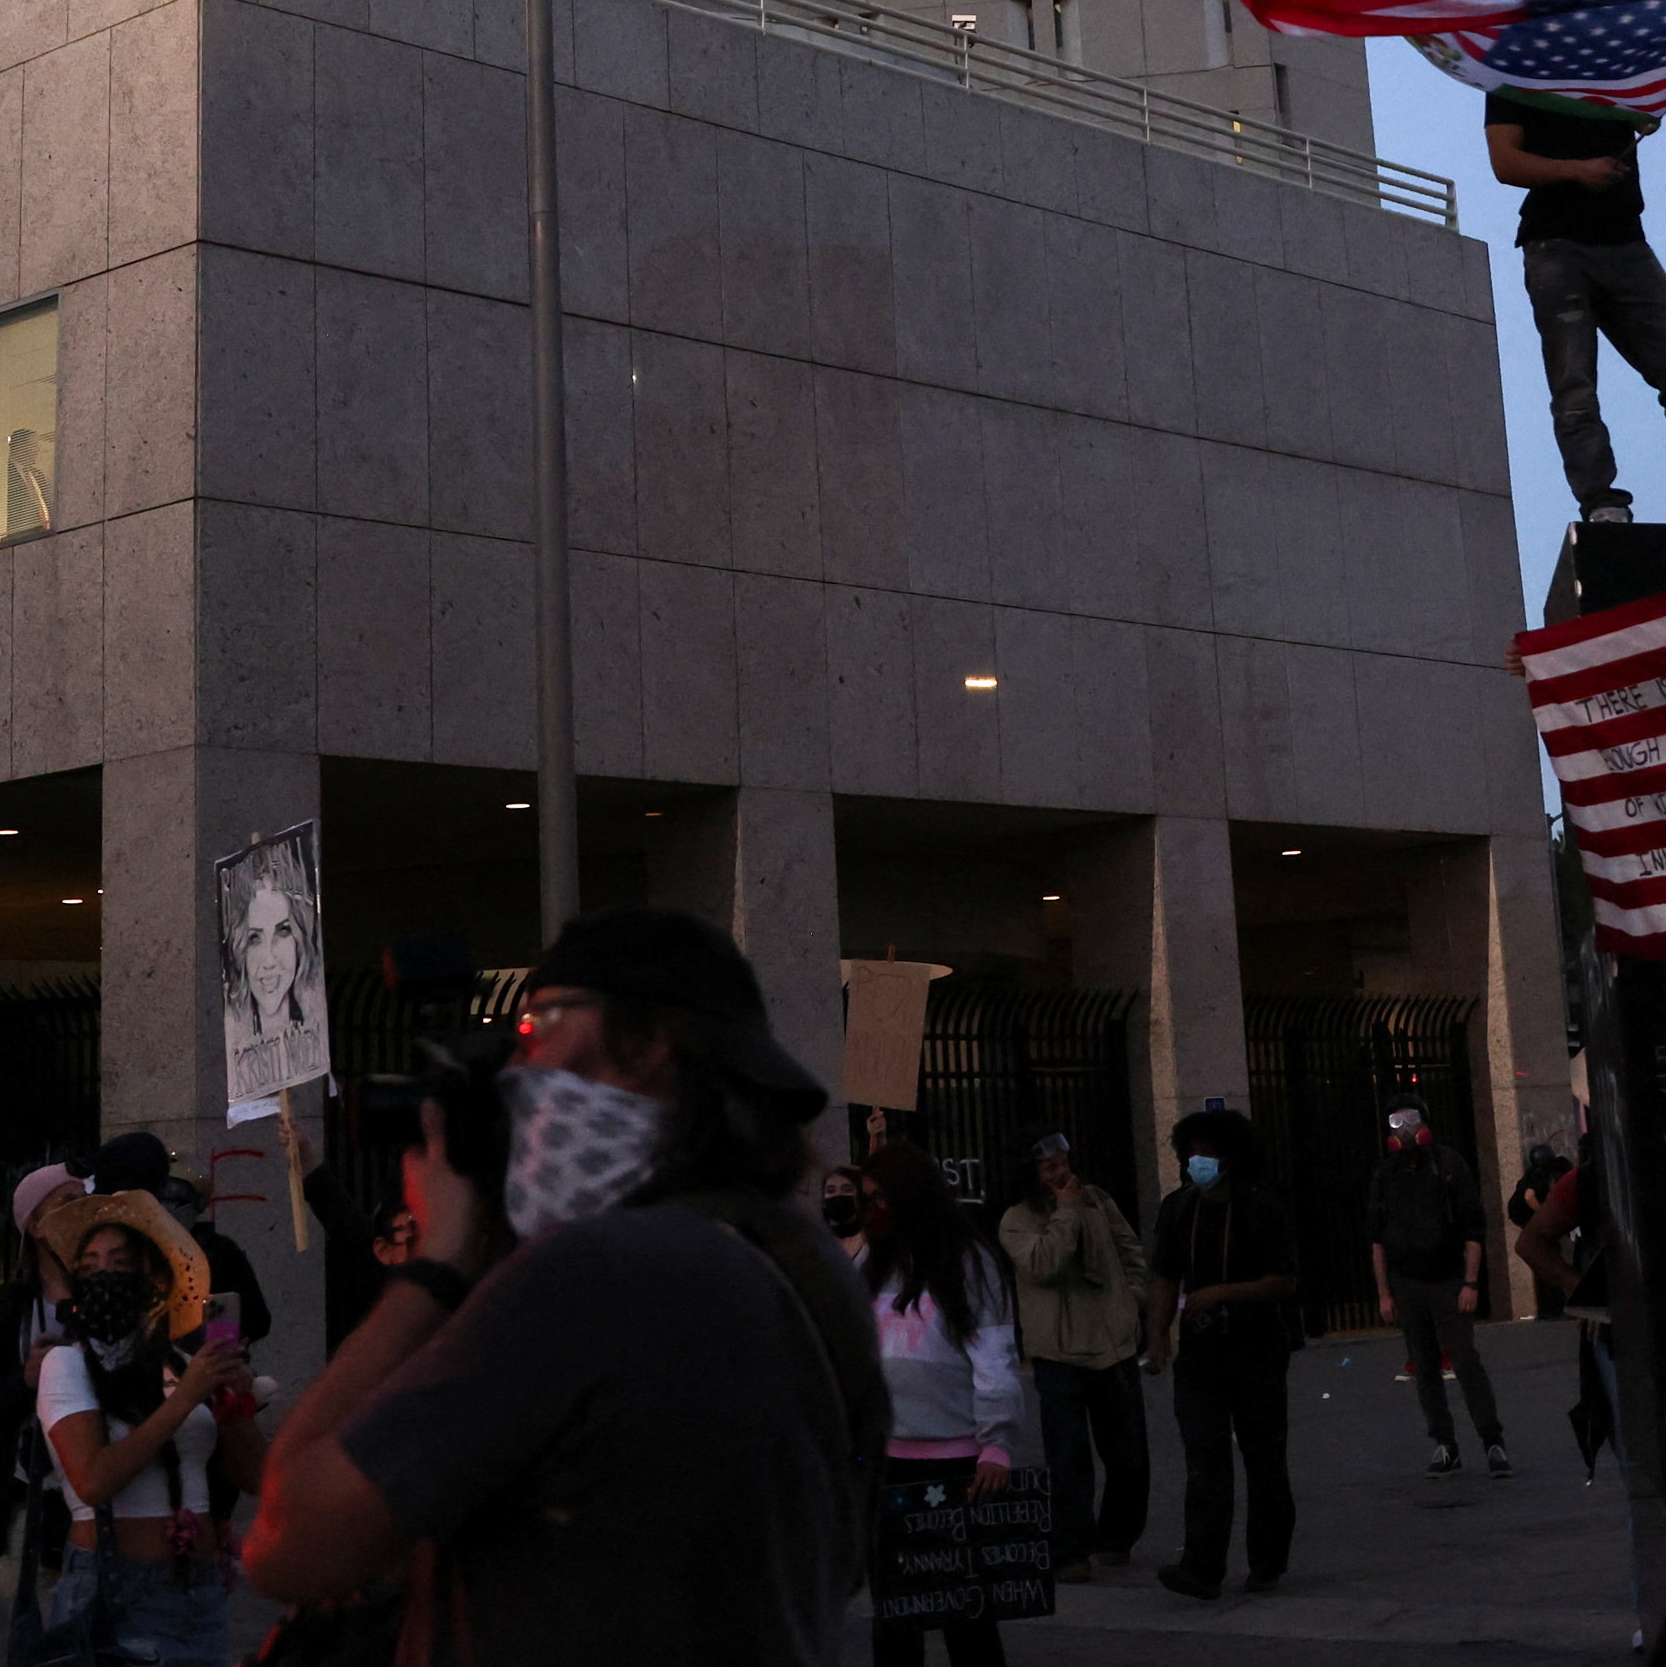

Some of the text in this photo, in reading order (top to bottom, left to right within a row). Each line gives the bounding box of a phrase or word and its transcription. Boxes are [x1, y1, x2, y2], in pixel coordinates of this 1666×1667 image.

[1575, 683, 1648, 723] THERE
[1625, 797, 1644, 817] OF
[1005, 1467, 1052, 1497] DUTY
[902, 1497, 1052, 1542] REBELLION BECOMES
[980, 1540, 1051, 1571] BECOMES
[881, 1578, 1048, 1620] WHEN GOVERNMENT
